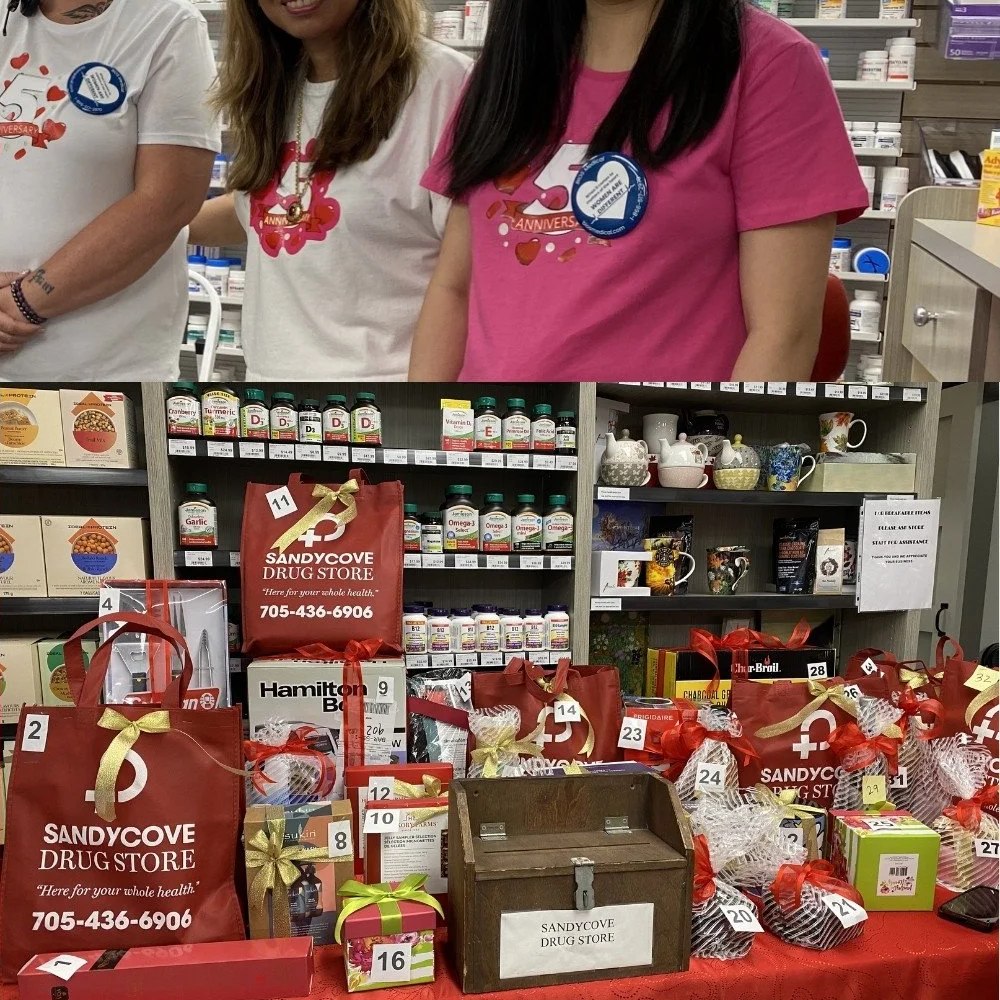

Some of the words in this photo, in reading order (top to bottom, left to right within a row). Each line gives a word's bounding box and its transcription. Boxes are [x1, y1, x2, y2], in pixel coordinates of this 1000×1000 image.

[985, 156, 1000, 164] Adv
[590, 190, 612, 210] WOMEN
[611, 179, 623, 192] ARE
[597, 188, 624, 214] DIFFERENT
[514, 216, 580, 232] ANNIVERSA
[168, 408, 197, 417] Cranberry
[204, 408, 236, 416] Turmeric
[485, 426, 493, 437] E
[272, 494, 290, 511] 11
[185, 518, 208, 526] Garlic
[448, 519, 475, 527] Omega-3
[485, 522, 508, 530] Omega-3
[547, 524, 573, 532] Omega-3
[265, 552, 374, 565] SANDYCOVE
[262, 567, 313, 580] DRUG
[317, 566, 374, 581] STORE
[284, 588, 299, 598] for
[299, 590, 320, 598] your
[321, 588, 345, 597] whole
[102, 597, 113, 611] 4
[260, 605, 373, 619] 705-436-6906
[809, 665, 826, 677] 28
[974, 673, 992, 683] 32
[260, 681, 368, 698] Hamilton
[378, 680, 389, 696] 9
[557, 704, 577, 716] 14
[27, 720, 42, 740] 2
[622, 727, 642, 742] 23
[698, 769, 721, 785] 24
[761, 766, 844, 783] SANDYCO
[370, 787, 391, 800] 12
[370, 812, 394, 825] 10
[43, 823, 196, 848] SANDYCOVE
[334, 831, 347, 850] 8
[981, 841, 1000, 854] 27
[38, 850, 110, 871] DRUG
[114, 849, 196, 873] STORE
[68, 883, 90, 900] for
[91, 886, 122, 900] your
[124, 885, 155, 898] whole
[832, 899, 857, 916] 21
[32, 908, 193, 931] 705-436-6906
[726, 908, 752, 924] 20
[541, 918, 615, 933] SANDYCOVE
[541, 936, 575, 948] DRUG
[578, 932, 615, 945] STORE
[377, 950, 406, 971] 16
